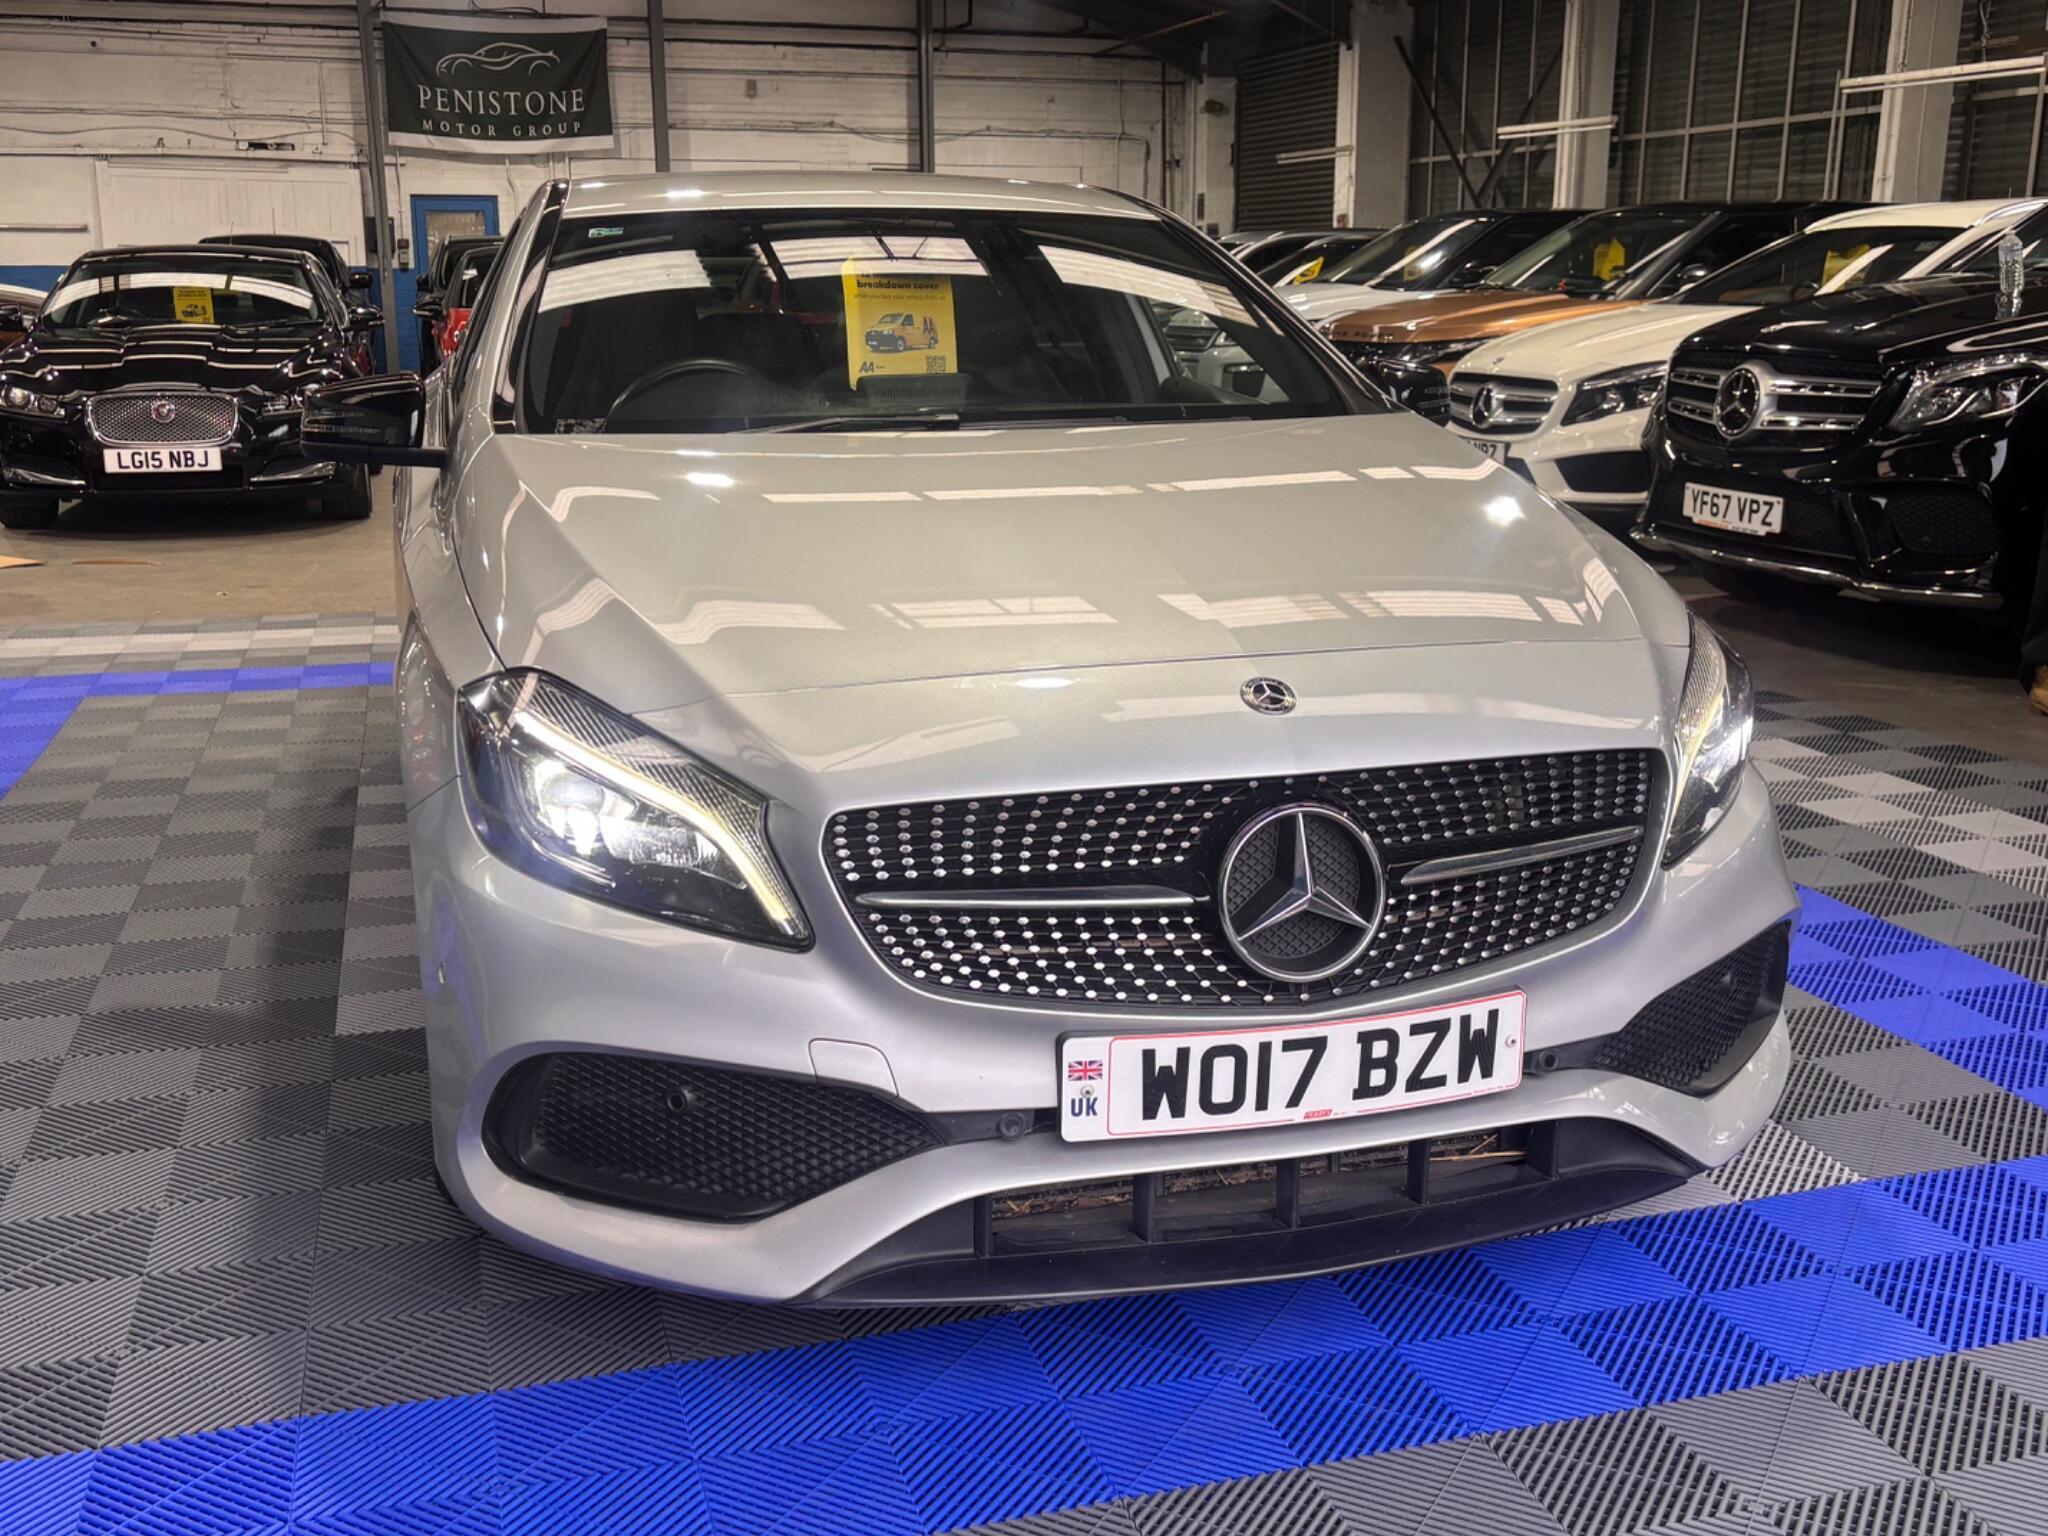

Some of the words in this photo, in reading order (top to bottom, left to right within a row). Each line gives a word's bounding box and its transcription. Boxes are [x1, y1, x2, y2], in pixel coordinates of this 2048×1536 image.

[417, 84, 585, 116] PENISTONE
[422, 118, 497, 136] MOTOR
[513, 121, 581, 137] GROUP
[857, 280, 911, 289] breakdown
[913, 282, 939, 290] cover
[923, 316, 935, 335] AA
[859, 361, 874, 373] AA
[117, 451, 163, 470] LG15
[168, 450, 209, 469] NBJ
[1692, 488, 1732, 519] YF67
[1738, 496, 1775, 527] VPZ
[1142, 1035, 1328, 1121] WO17
[1352, 1008, 1499, 1101] BZW
[1070, 1097, 1098, 1118] UK
